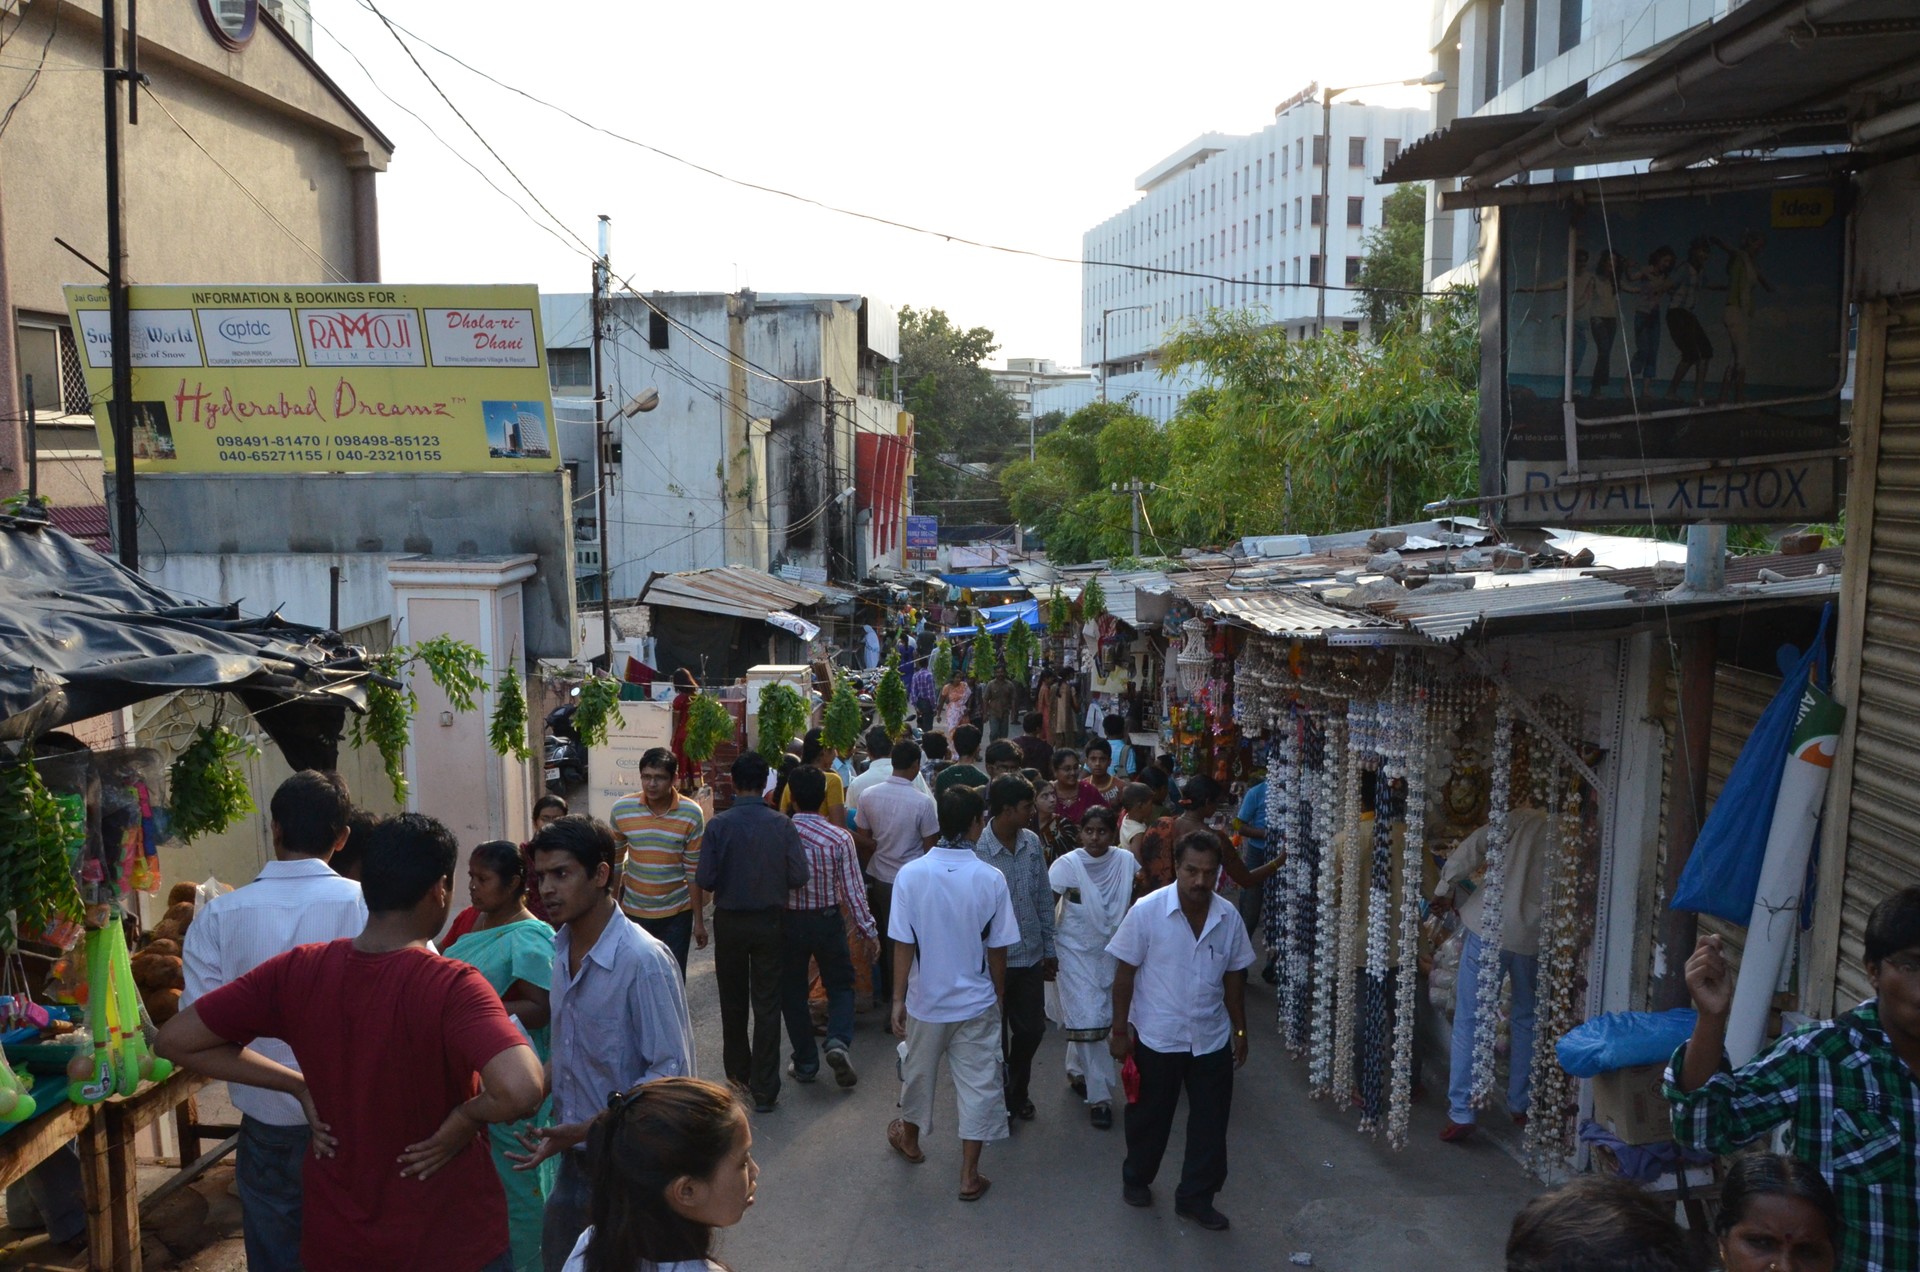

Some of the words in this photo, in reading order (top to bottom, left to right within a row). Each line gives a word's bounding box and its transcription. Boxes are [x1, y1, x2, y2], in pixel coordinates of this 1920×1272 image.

[88, 294, 107, 302] Guru
[192, 292, 280, 304] INFORMATION
[284, 292, 292, 303] &
[296, 292, 365, 303] BOOKINGS
[369, 292, 396, 303] FOR
[147, 326, 193, 343] World
[226, 320, 270, 339] aptdc
[308, 312, 411, 348] RAMOJI
[473, 332, 523, 349] Dhani
[132, 351, 147, 360] agic
[173, 378, 326, 430] Hyderabad
[334, 376, 455, 419] Dreamz
[216, 436, 321, 446] 098491-81470
[334, 435, 440, 446] 098498-85123
[220, 450, 323, 461] 040-65271155
[336, 450, 442, 461] 040-23210155
[1667, 467, 1808, 508] XEROX
